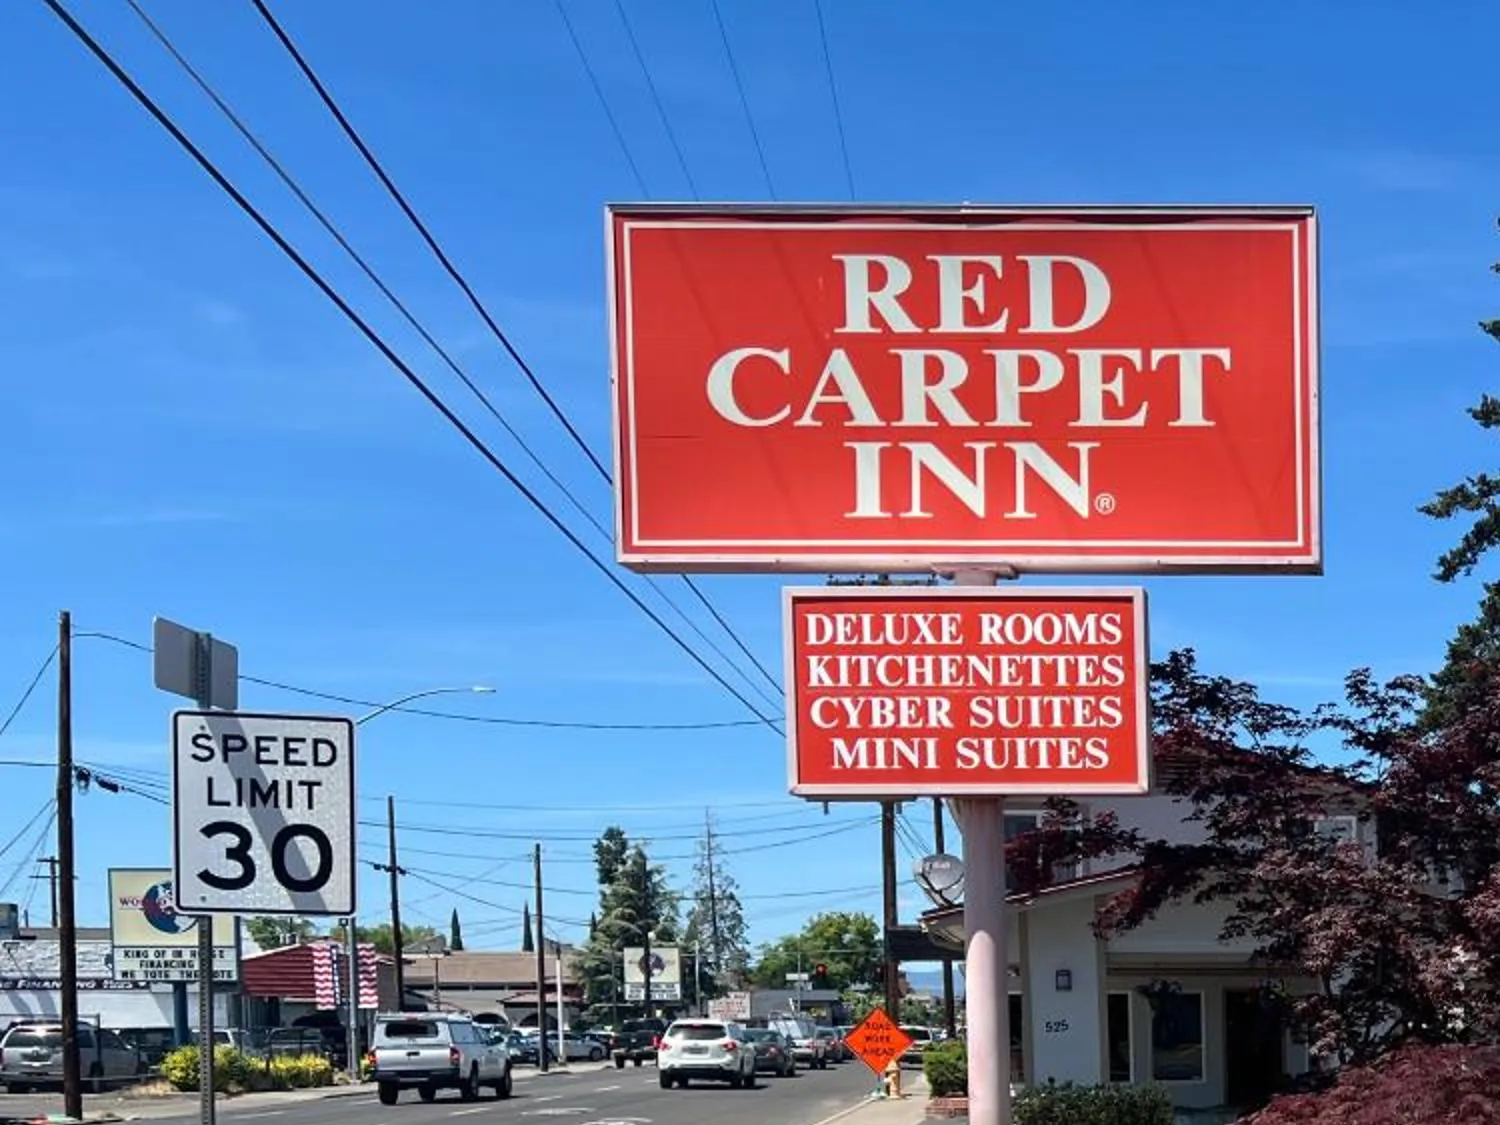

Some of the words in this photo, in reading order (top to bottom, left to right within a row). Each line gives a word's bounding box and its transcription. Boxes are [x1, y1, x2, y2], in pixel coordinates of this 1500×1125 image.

[832, 255, 1111, 333] RED
[707, 348, 1230, 426] CARPET
[806, 614, 963, 645] DELUXE
[980, 613, 1122, 644] ROOMS
[808, 655, 1124, 686] KITCHENETTES
[811, 696, 953, 728] CYBER
[970, 696, 1122, 728] SUITES
[191, 733, 338, 767] SPEED
[832, 738, 937, 768] MINI
[957, 738, 1108, 769] SUITES
[207, 777, 322, 810] LIMIT
[197, 820, 333, 893] 30
[123, 950, 149, 959] KING
[153, 950, 165, 959] OF
[139, 960, 195, 969] FINANCING
[16, 979, 97, 989] FINANNG
[1045, 1020, 1069, 1032] 525
